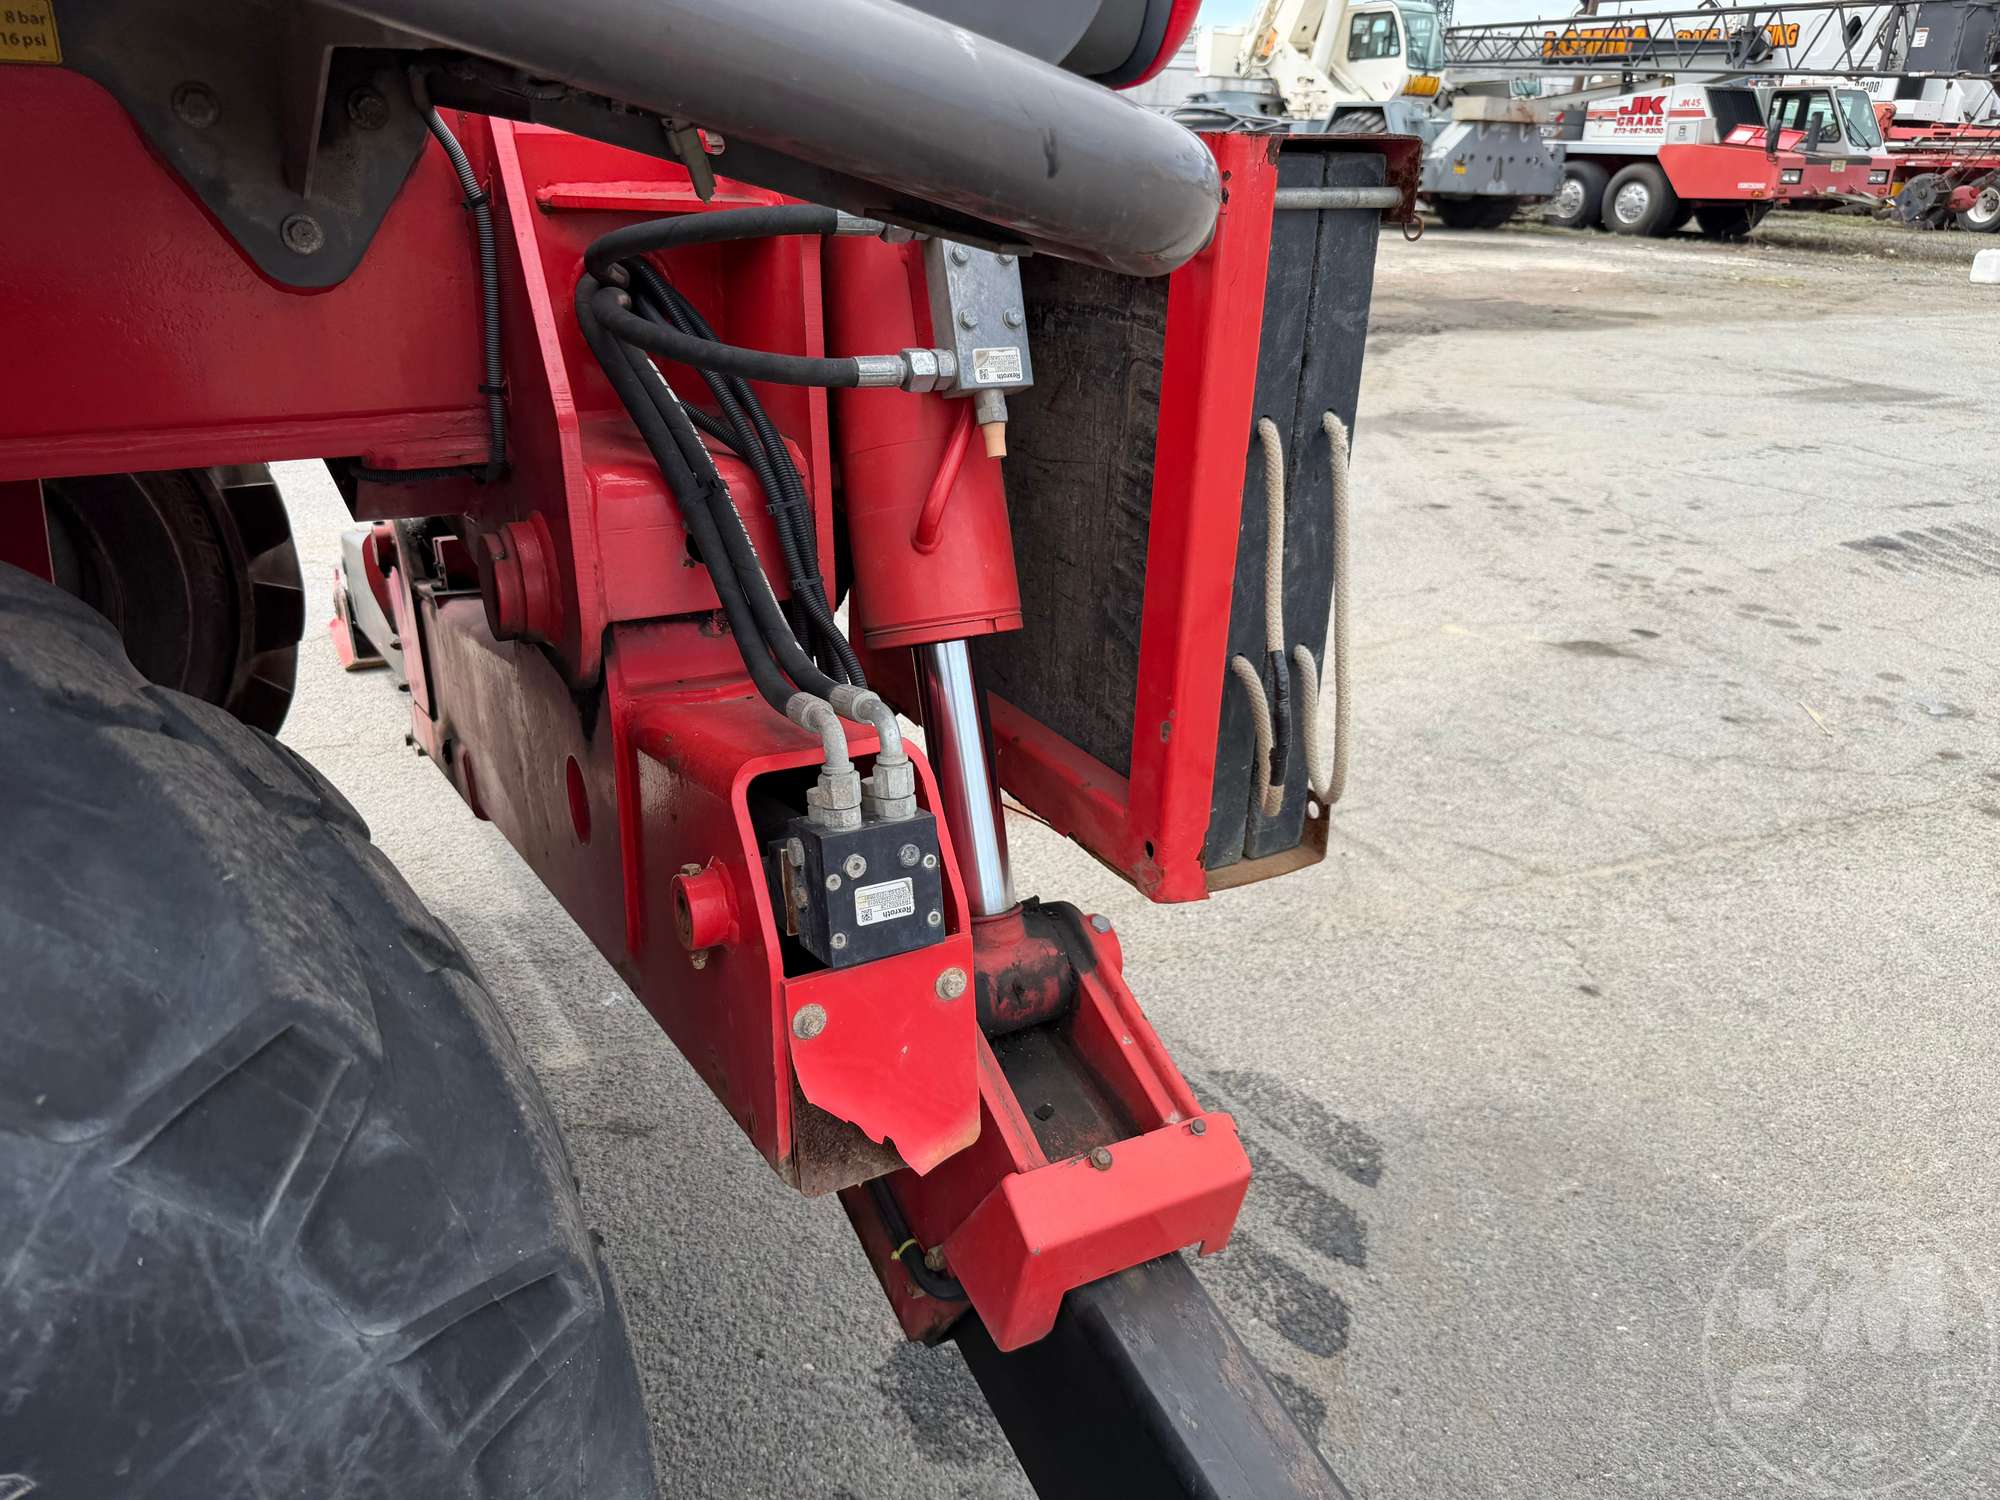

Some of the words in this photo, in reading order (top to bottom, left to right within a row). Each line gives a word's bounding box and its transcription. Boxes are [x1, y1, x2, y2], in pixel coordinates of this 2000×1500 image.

[1618, 96, 1668, 115] JK
[1616, 116, 1664, 126] CRANE
[996, 372, 1021, 381] Rexroth
[882, 906, 912, 918] Rexroth
